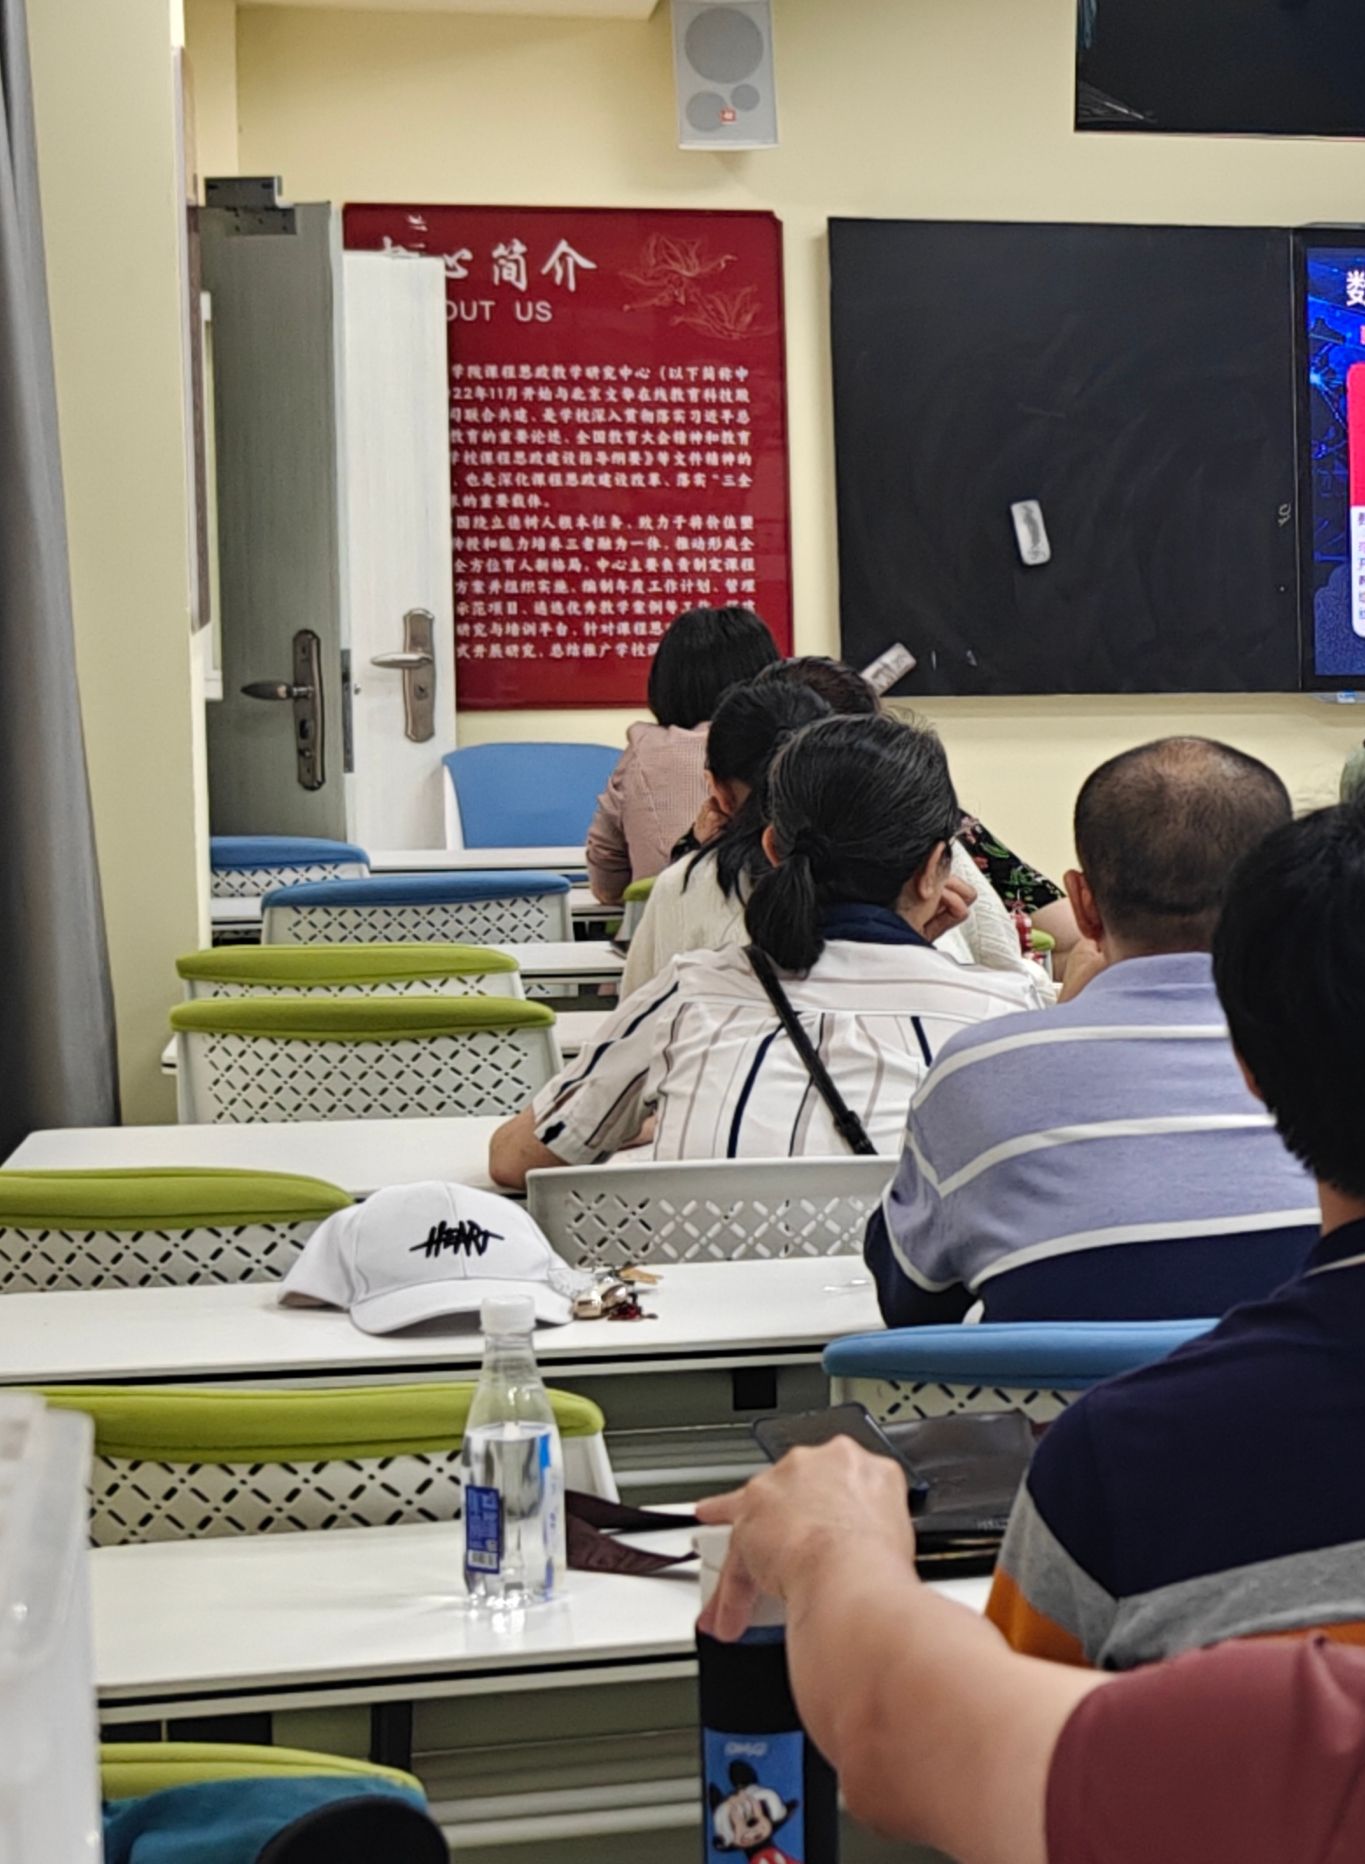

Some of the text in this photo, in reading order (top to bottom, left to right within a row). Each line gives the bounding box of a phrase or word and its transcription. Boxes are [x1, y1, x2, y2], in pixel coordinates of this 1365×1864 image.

[383, 236, 597, 292] 心简介
[447, 301, 552, 322] OUT US
[409, 1219, 504, 1259] HEART
